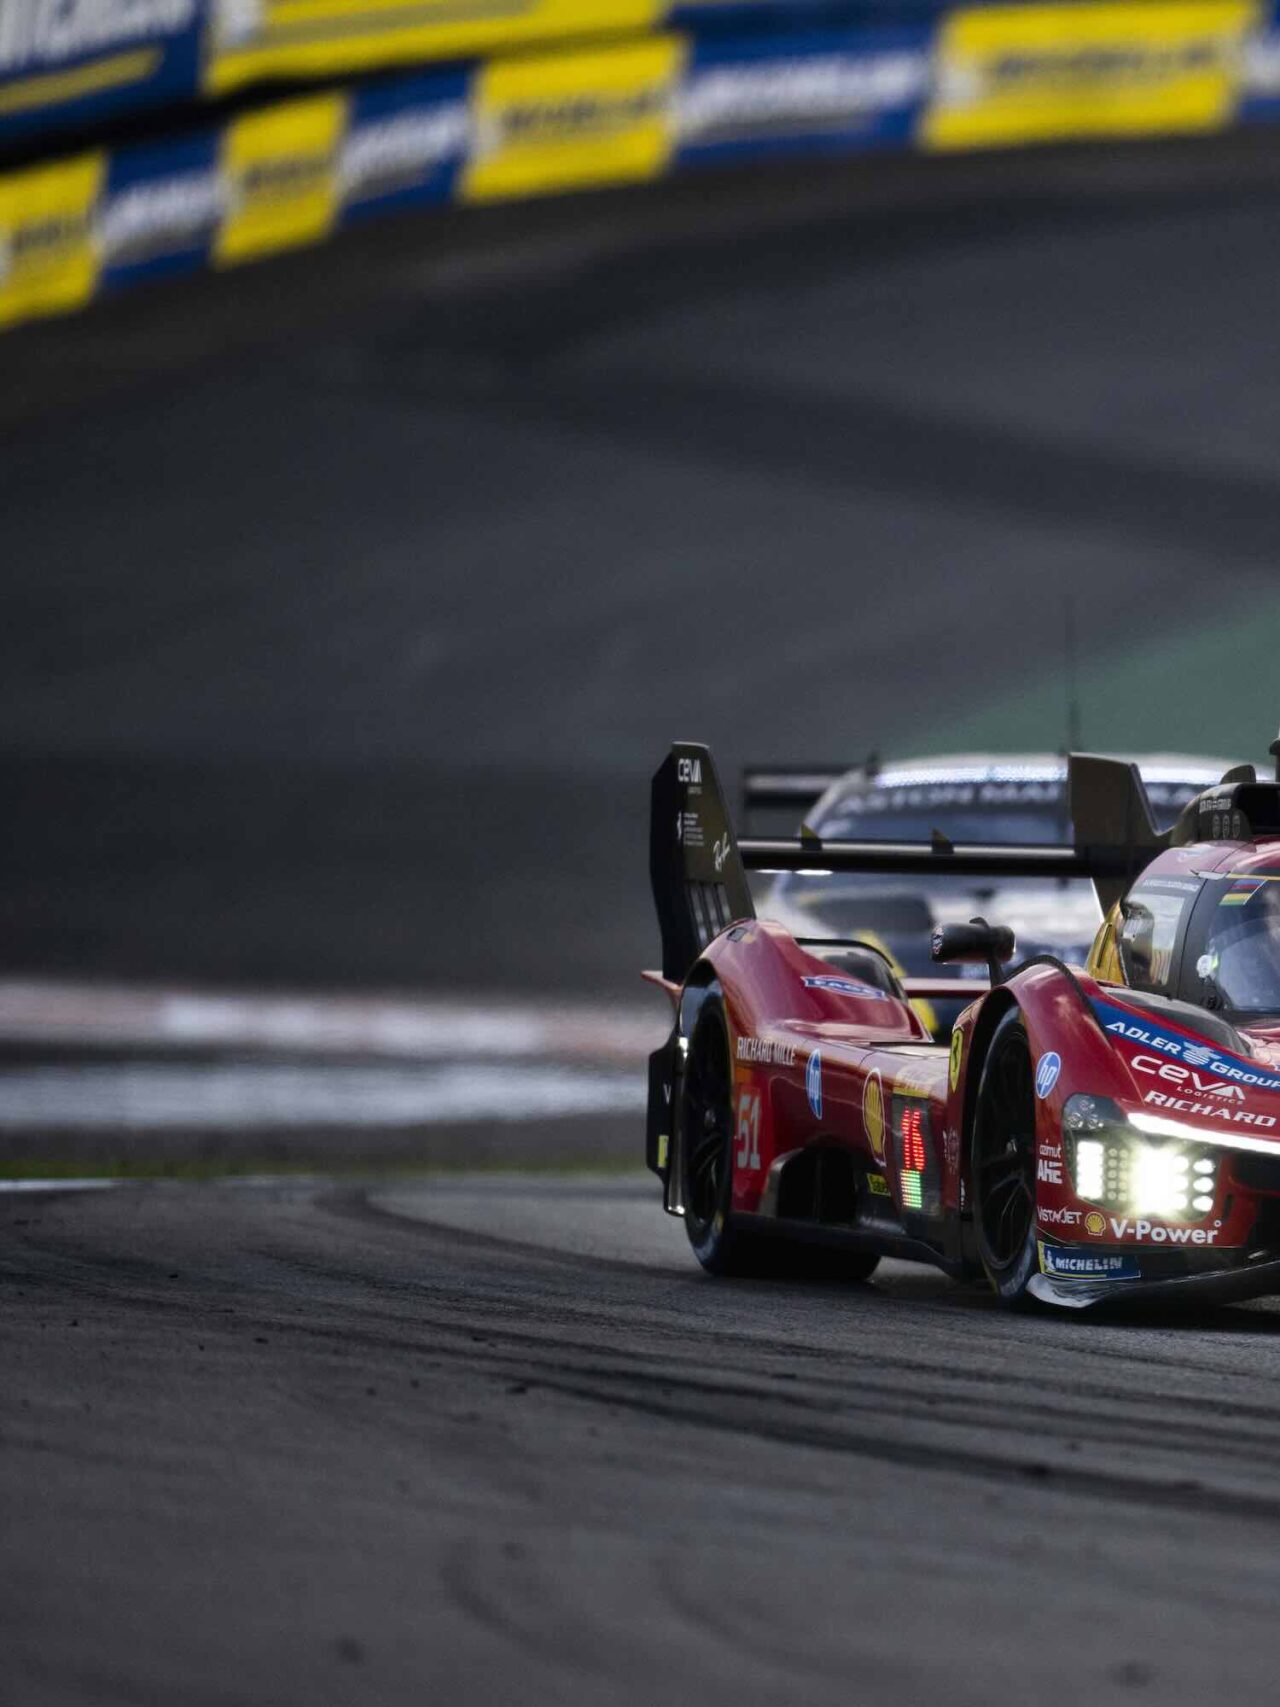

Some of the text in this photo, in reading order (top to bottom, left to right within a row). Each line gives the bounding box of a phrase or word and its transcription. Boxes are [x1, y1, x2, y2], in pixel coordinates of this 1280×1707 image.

[1105, 1021, 1182, 1055] ADLER
[1036, 1053, 1059, 1098] hp
[1144, 1090, 1277, 1127] RICHARD
[1110, 1217, 1219, 1244] V-Power
[1055, 1256, 1123, 1271] MICHELIN
